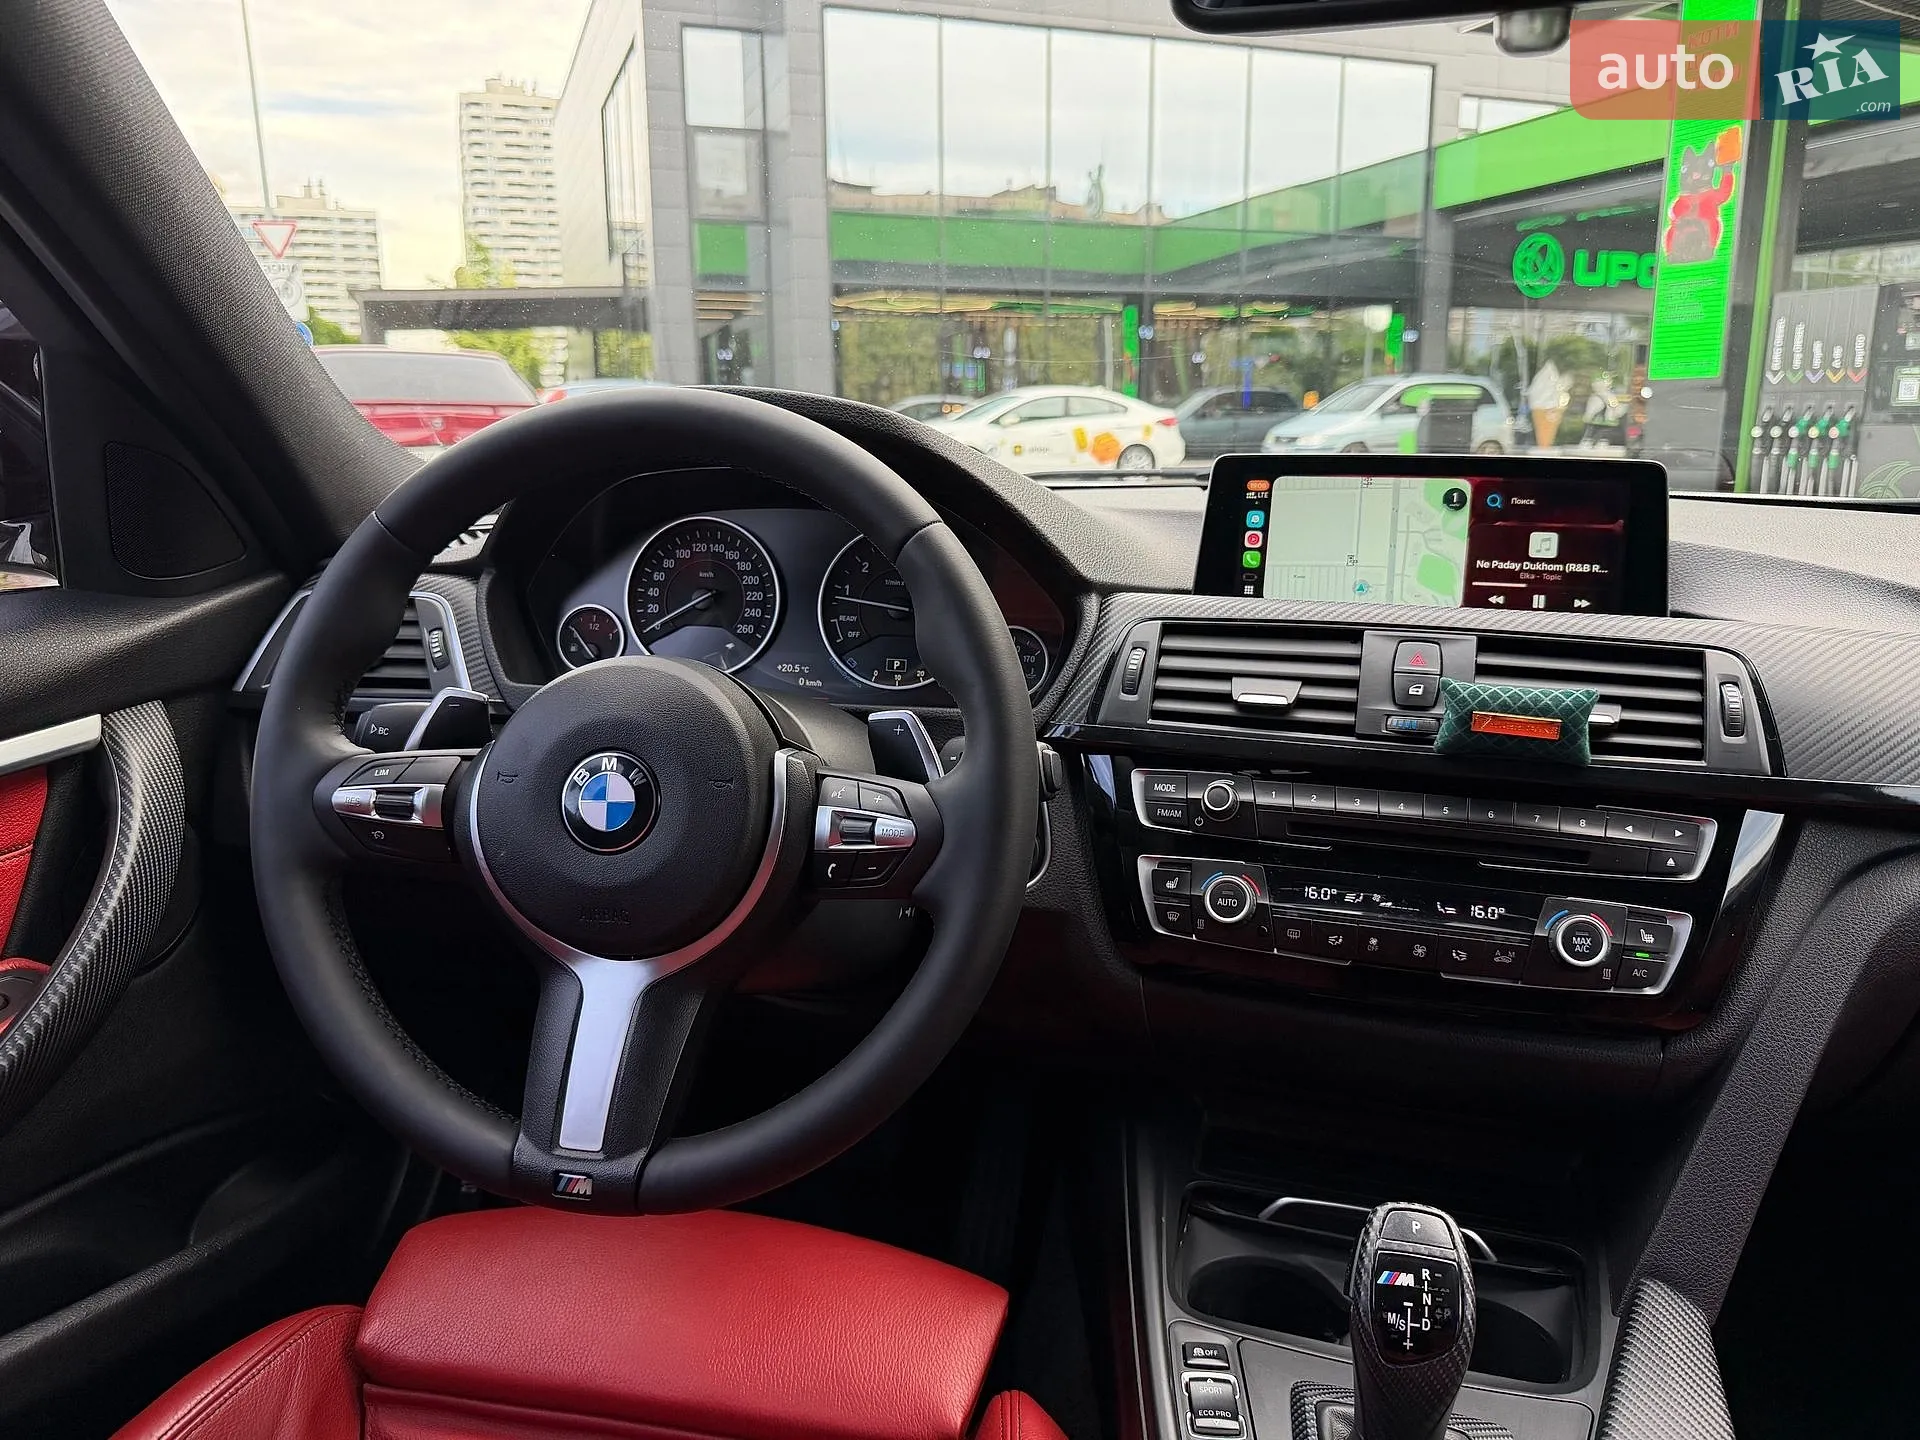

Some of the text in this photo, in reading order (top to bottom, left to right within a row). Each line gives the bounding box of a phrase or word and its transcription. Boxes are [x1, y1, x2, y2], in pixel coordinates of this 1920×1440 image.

[692, 543, 707, 552] 120
[709, 544, 724, 552] 140
[675, 549, 691, 559] 100
[724, 551, 740, 560] 160
[663, 559, 675, 568] 80
[736, 562, 751, 570] 180
[862, 562, 870, 573] 2
[1476, 560, 1490, 569] Ne
[1492, 561, 1521, 571] Paday
[1523, 562, 1563, 571] Dukhom
[1565, 563, 1590, 573] (R&B
[653, 572, 665, 581] 60
[742, 576, 759, 585] 200
[1520, 572, 1535, 580] Elka
[1543, 573, 1562, 581] Topic
[647, 588, 659, 597] 40
[844, 585, 850, 595] 1
[746, 591, 763, 601] 220
[647, 604, 659, 613] 20
[744, 608, 761, 617] 240
[589, 623, 599, 631] 1/2
[736, 624, 753, 634] 260
[777, 664, 800, 673] +20.5
[893, 660, 900, 669] P
[799, 677, 822, 687] 0 km/h
[378, 727, 389, 736] BC
[374, 768, 390, 777] LIM
[574, 757, 647, 787] BMW
[1154, 783, 1176, 793] MODE
[1311, 794, 1317, 802] 2
[1354, 798, 1360, 806] 3
[1398, 802, 1404, 810] 4
[1443, 806, 1448, 814] 5
[1157, 808, 1182, 818] FM/AM
[1488, 810, 1493, 818] 6
[1534, 814, 1540, 822] 7
[1580, 819, 1585, 827] 8
[881, 827, 905, 838] MODE
[1304, 886, 1337, 900] 16.0°
[1217, 898, 1238, 908] AUTO
[1470, 904, 1505, 920] 16.0°
[1572, 937, 1592, 945] MAX
[1575, 945, 1590, 953] A/C
[1632, 968, 1648, 977] A/C
[1412, 1220, 1420, 1234] P
[1421, 1268, 1431, 1280] R
[1422, 1293, 1432, 1305] N
[1387, 1312, 1406, 1331] M/S
[1421, 1318, 1431, 1331] D
[1199, 1386, 1222, 1394] SPORT
[1215, 1410, 1231, 1418] PRO
